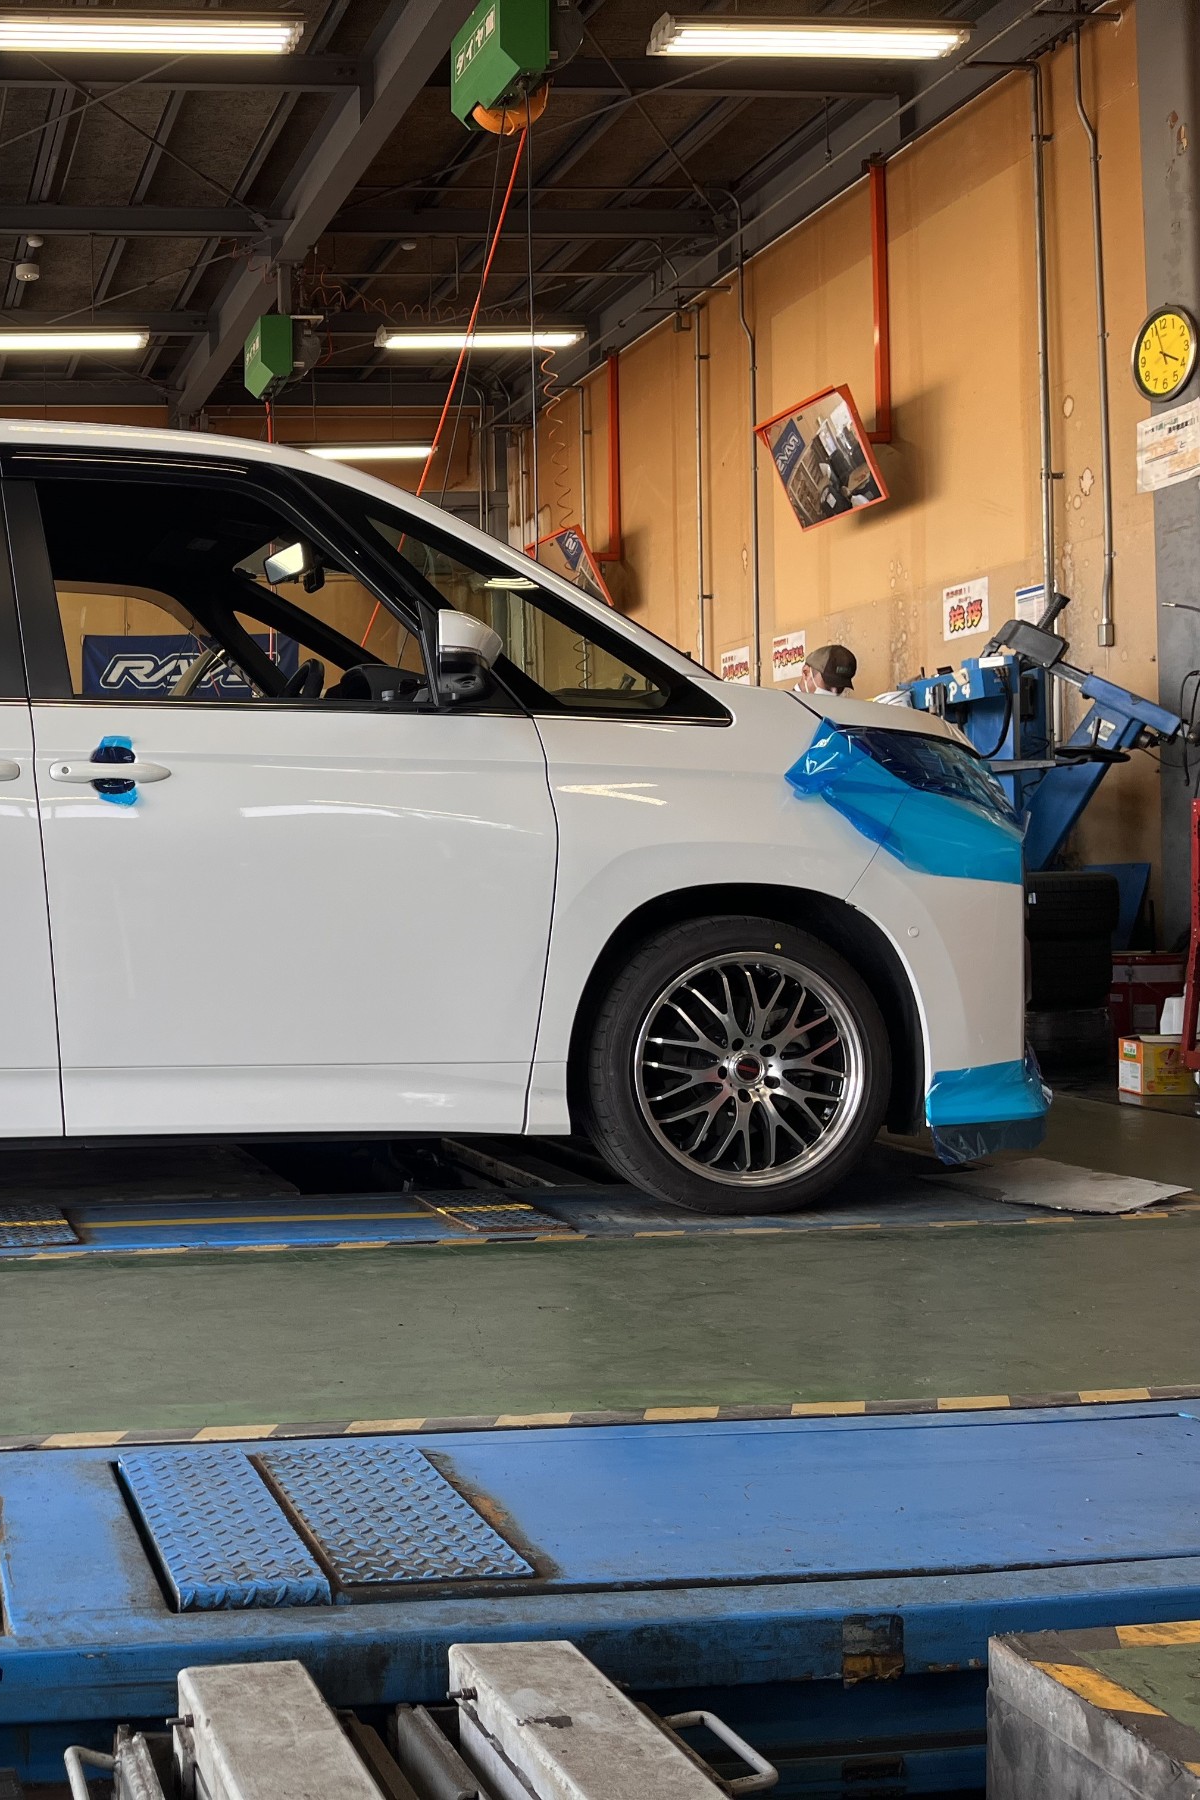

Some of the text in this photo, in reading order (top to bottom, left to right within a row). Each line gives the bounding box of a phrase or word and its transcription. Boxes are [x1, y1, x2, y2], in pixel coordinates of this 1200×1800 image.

[1159, 318, 1167, 330] 12
[1180, 325, 1186, 337] 2
[1143, 339, 1152, 351] 10
[1183, 340, 1190, 351] 3
[1140, 356, 1147, 368] 9
[1180, 357, 1186, 367] 4
[1144, 370, 1151, 382] 8
[1172, 370, 1179, 382] 5
[1152, 378, 1159, 389] 7
[1162, 378, 1169, 390] 6
